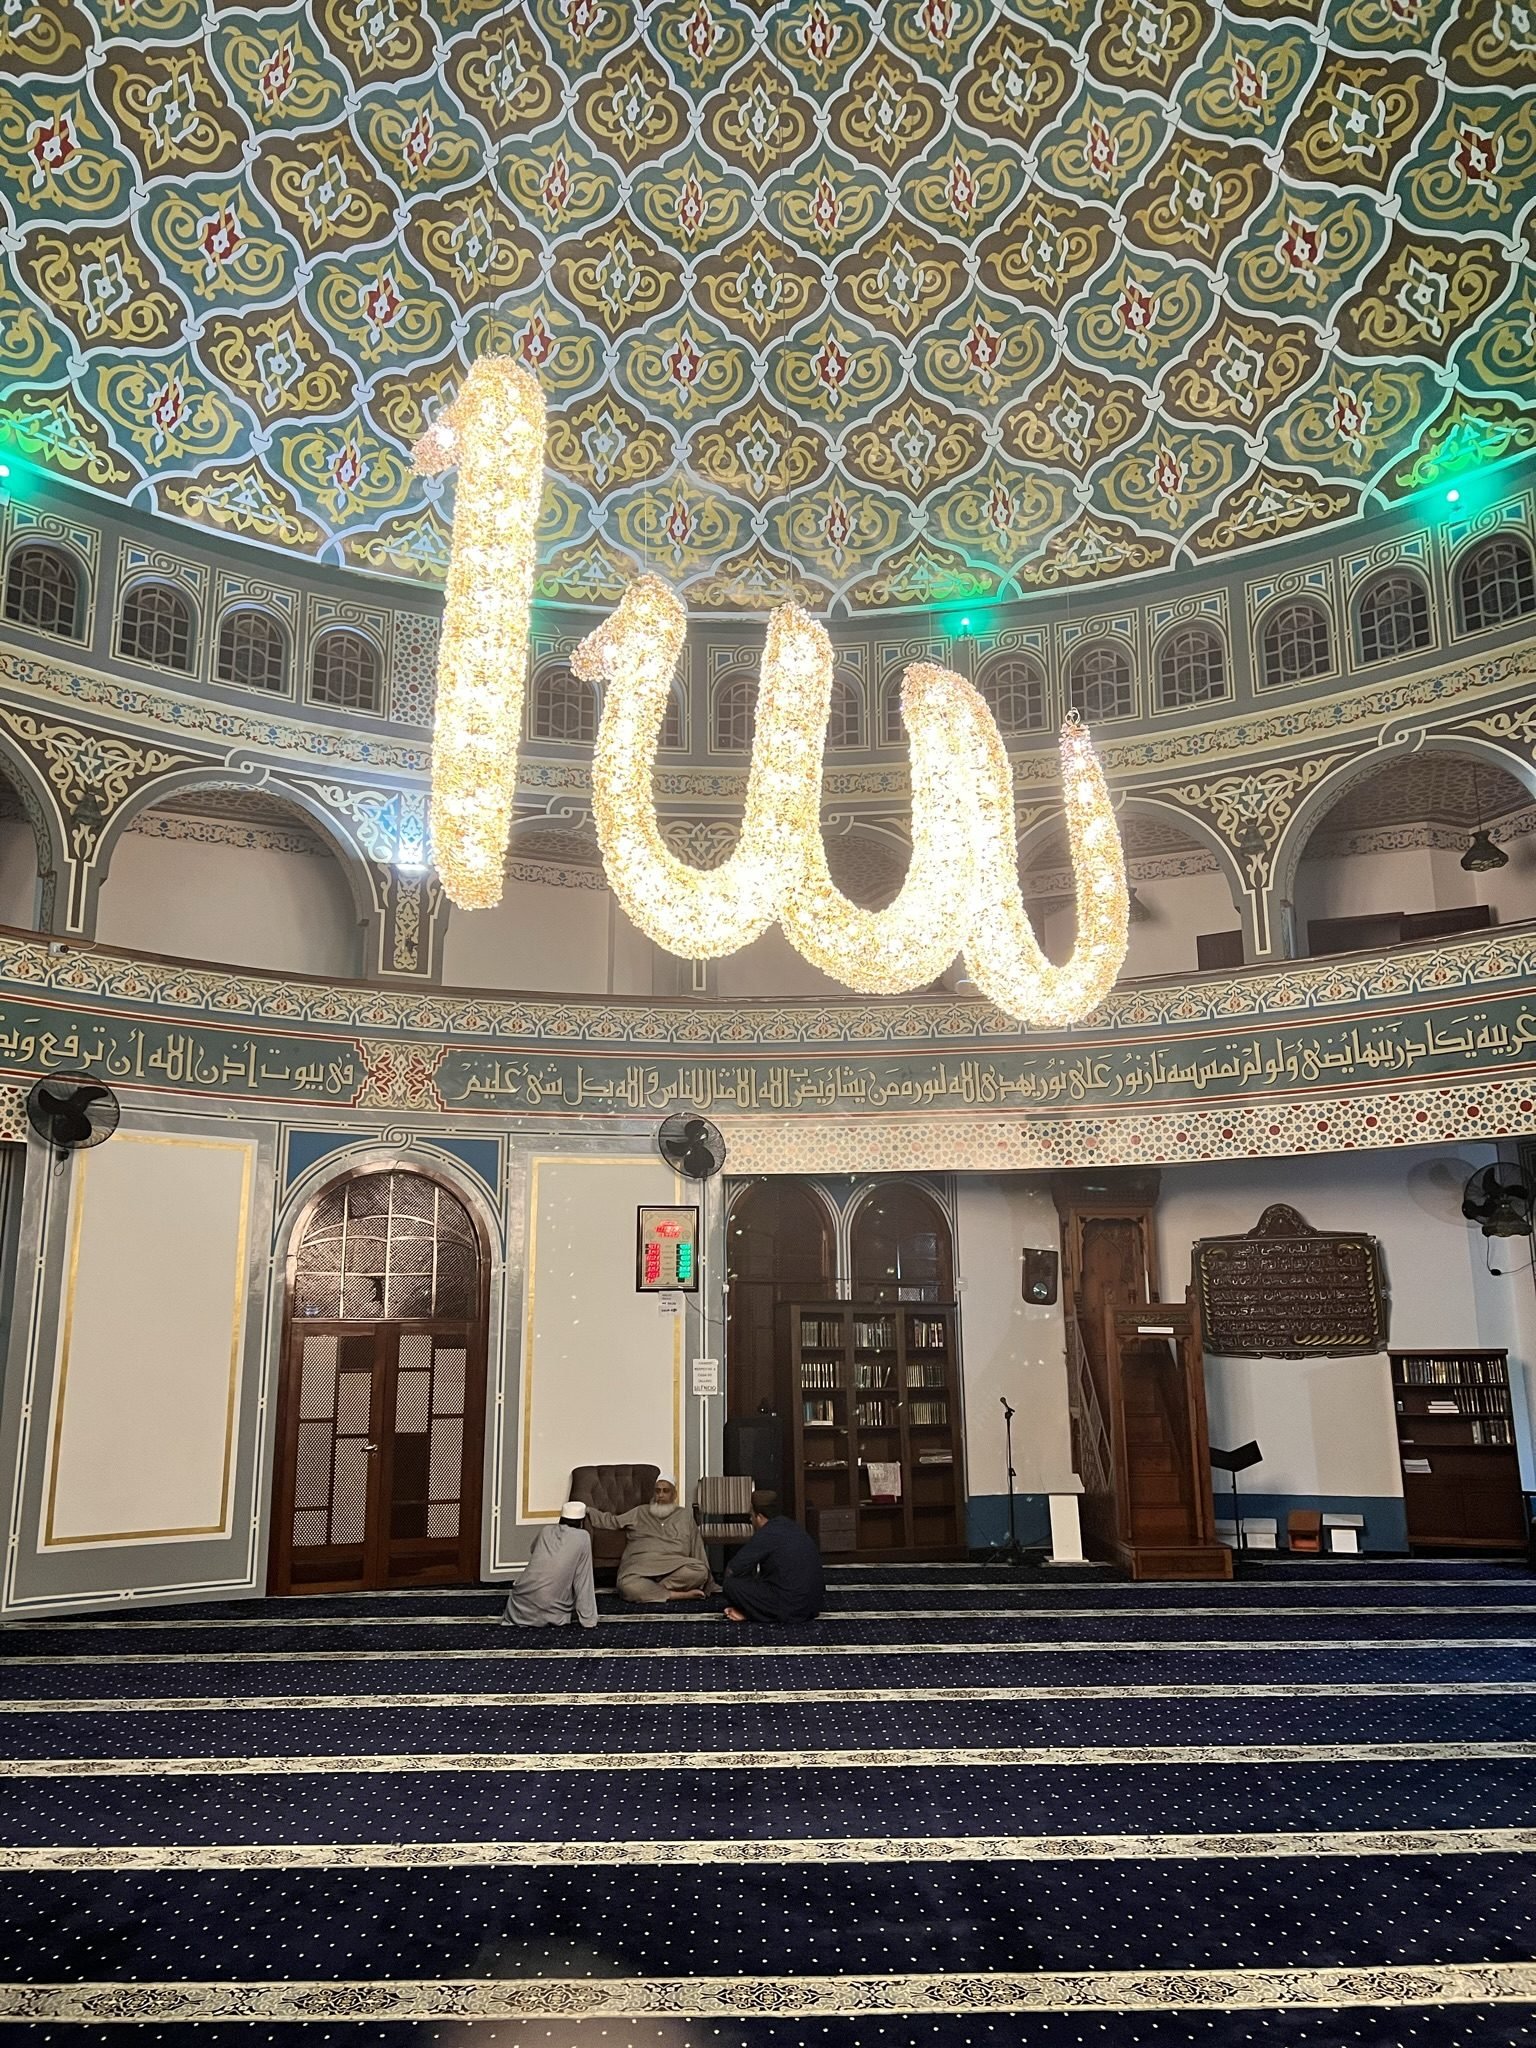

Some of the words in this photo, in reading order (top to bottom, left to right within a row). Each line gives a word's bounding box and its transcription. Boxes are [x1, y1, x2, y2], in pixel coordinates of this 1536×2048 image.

[149, 1034, 195, 1083] الله
[260, 1049, 324, 1091] بيوت
[950, 1060, 985, 1103] الله
